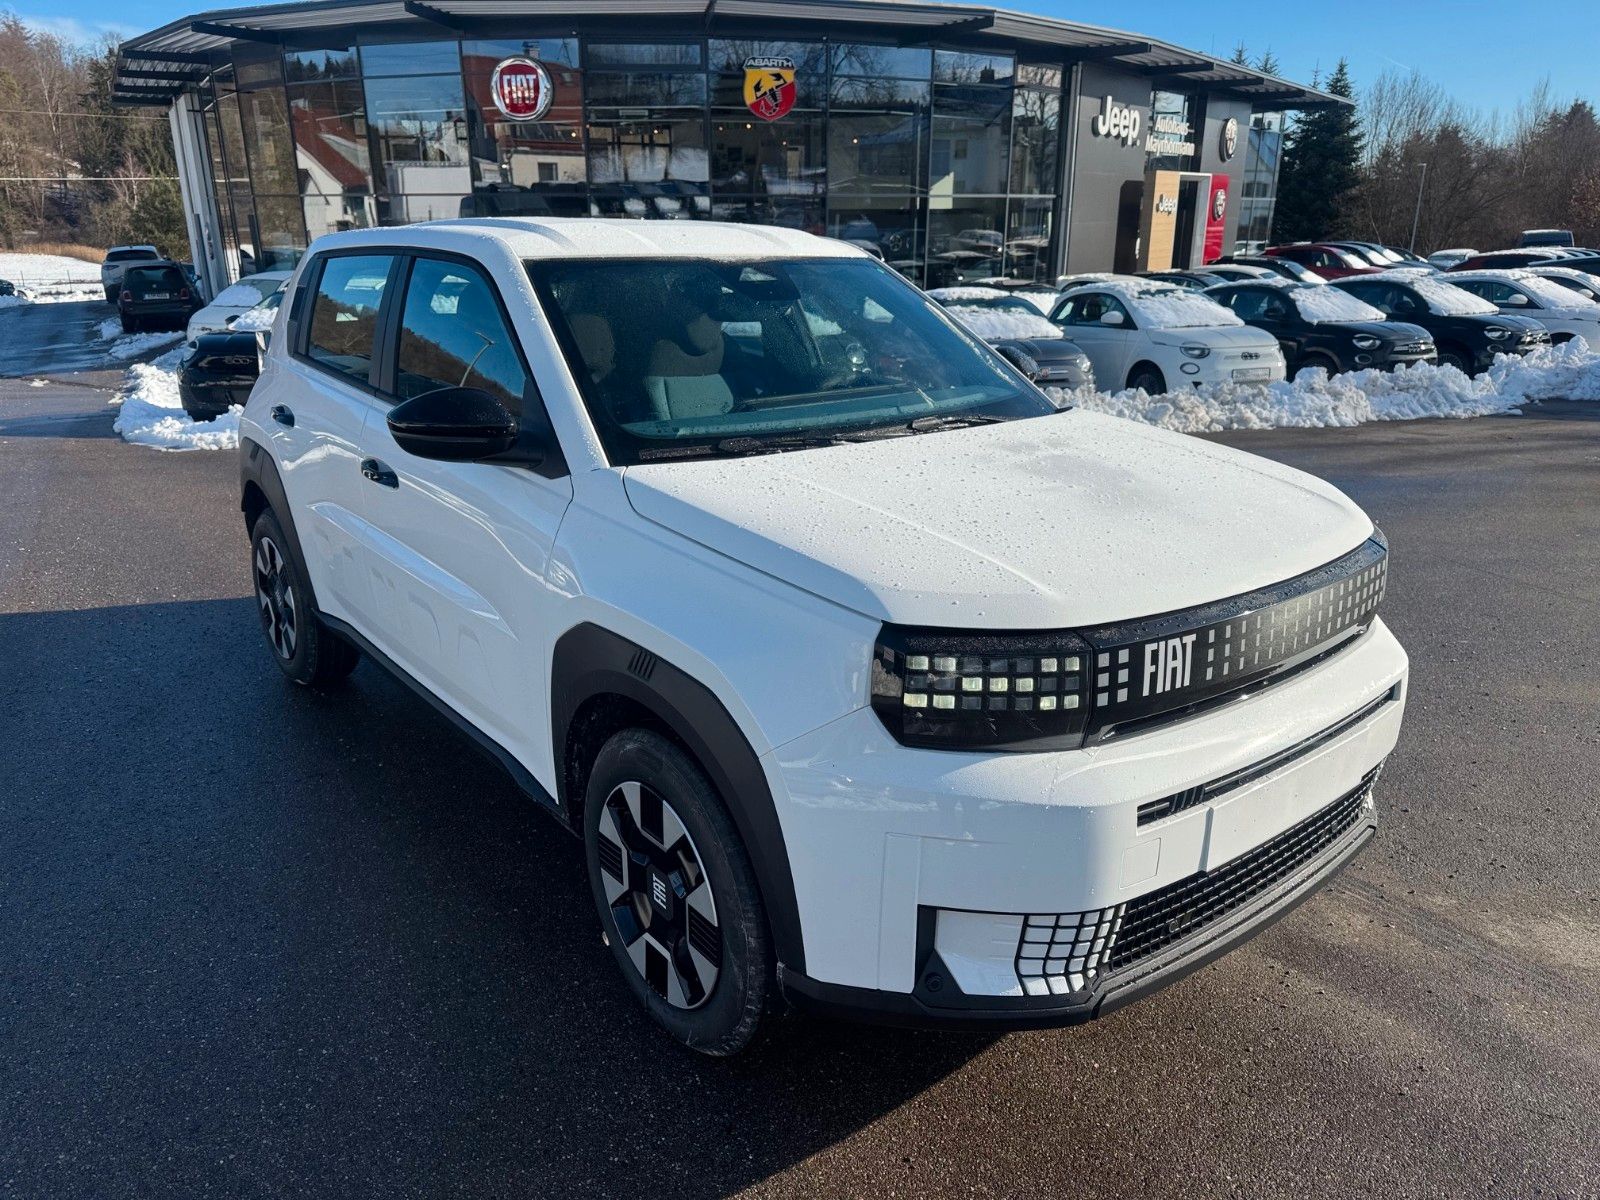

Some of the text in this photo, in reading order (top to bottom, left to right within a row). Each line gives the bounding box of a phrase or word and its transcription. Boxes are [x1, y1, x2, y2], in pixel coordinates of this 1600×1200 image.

[747, 58, 792, 67] ABARTH
[503, 74, 537, 104] FIAT
[1098, 95, 1141, 146] Jeep
[1155, 114, 1190, 136] Autohaus
[1158, 194, 1178, 214] Jeep
[1141, 633, 1197, 696] FIAT
[652, 873, 667, 909] FIAT
